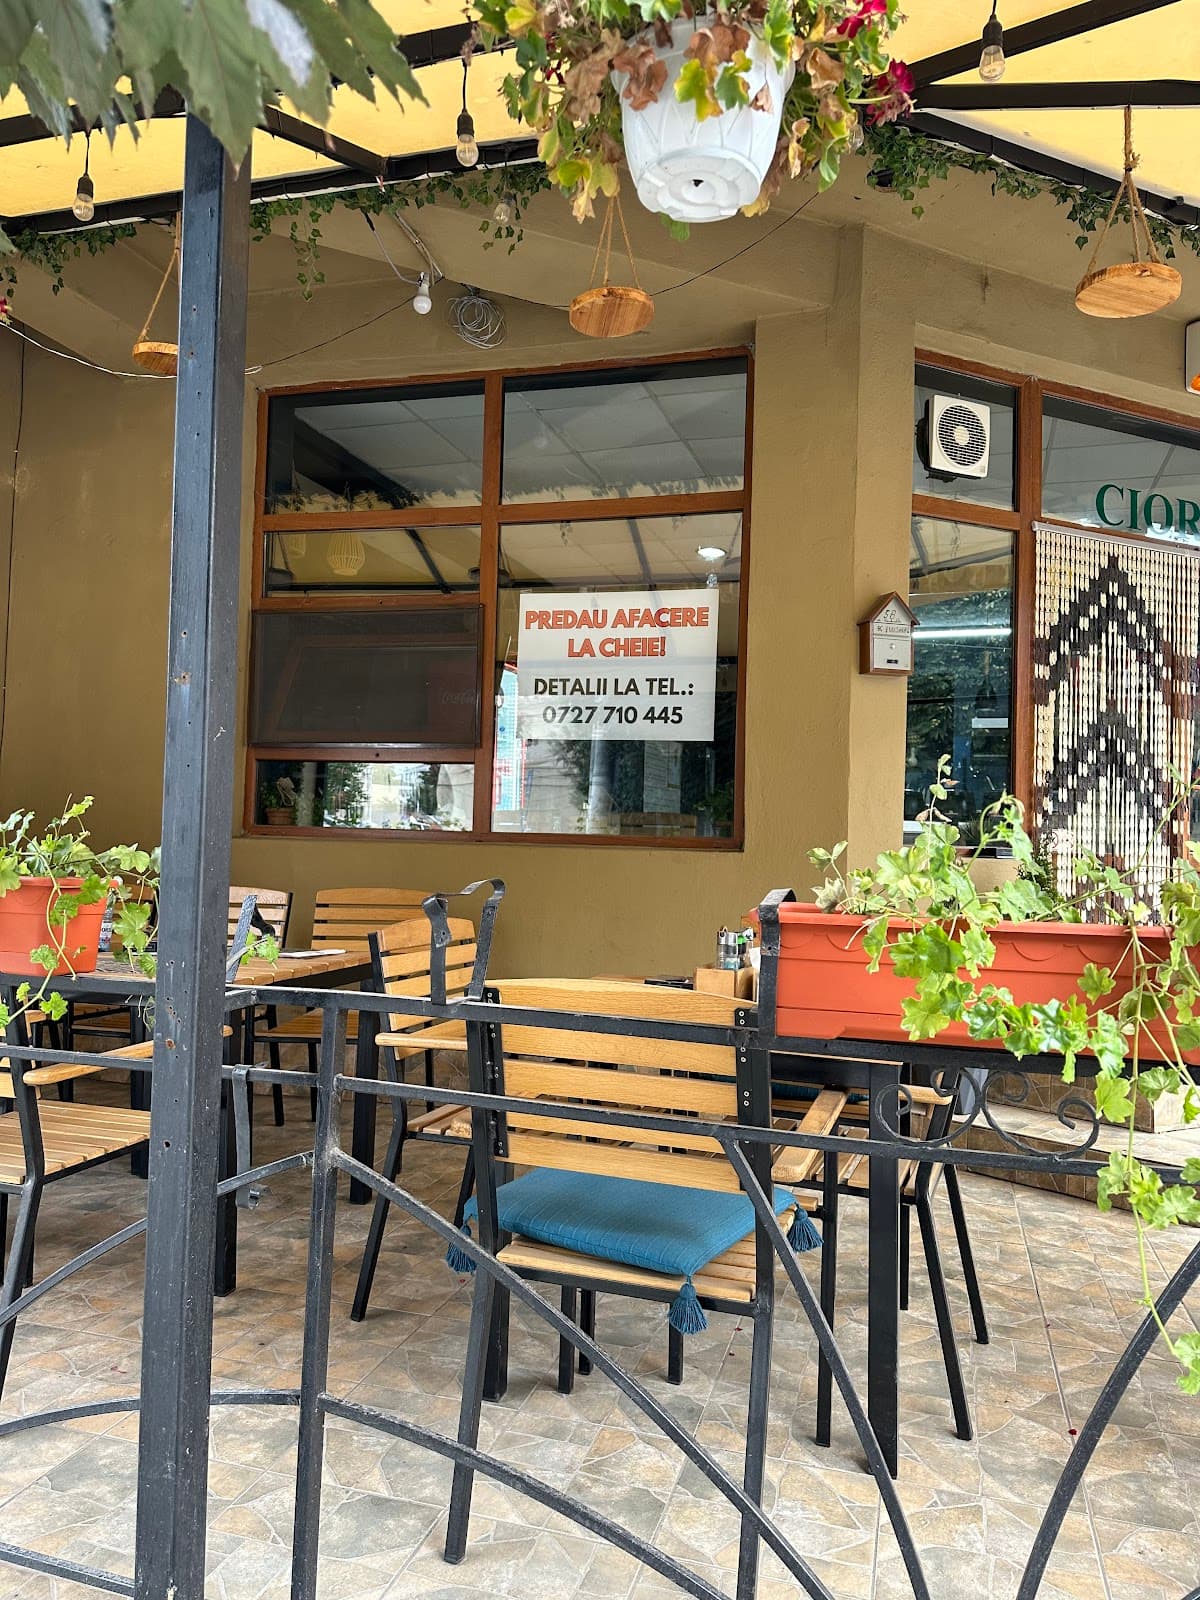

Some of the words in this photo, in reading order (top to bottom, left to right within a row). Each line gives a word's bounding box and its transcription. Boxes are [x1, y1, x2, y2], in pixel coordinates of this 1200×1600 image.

[1096, 484, 1200, 537] CIOR
[525, 609, 608, 629] PREDAU
[611, 607, 710, 628] AFACERE
[567, 638, 596, 657] LA
[598, 636, 667, 657] CHEIE!
[534, 678, 608, 696] DETALII
[614, 678, 640, 696] LA
[645, 677, 694, 696] TEL.:
[542, 706, 598, 724] 0727
[603, 706, 638, 724] 710
[643, 706, 683, 724] 445
